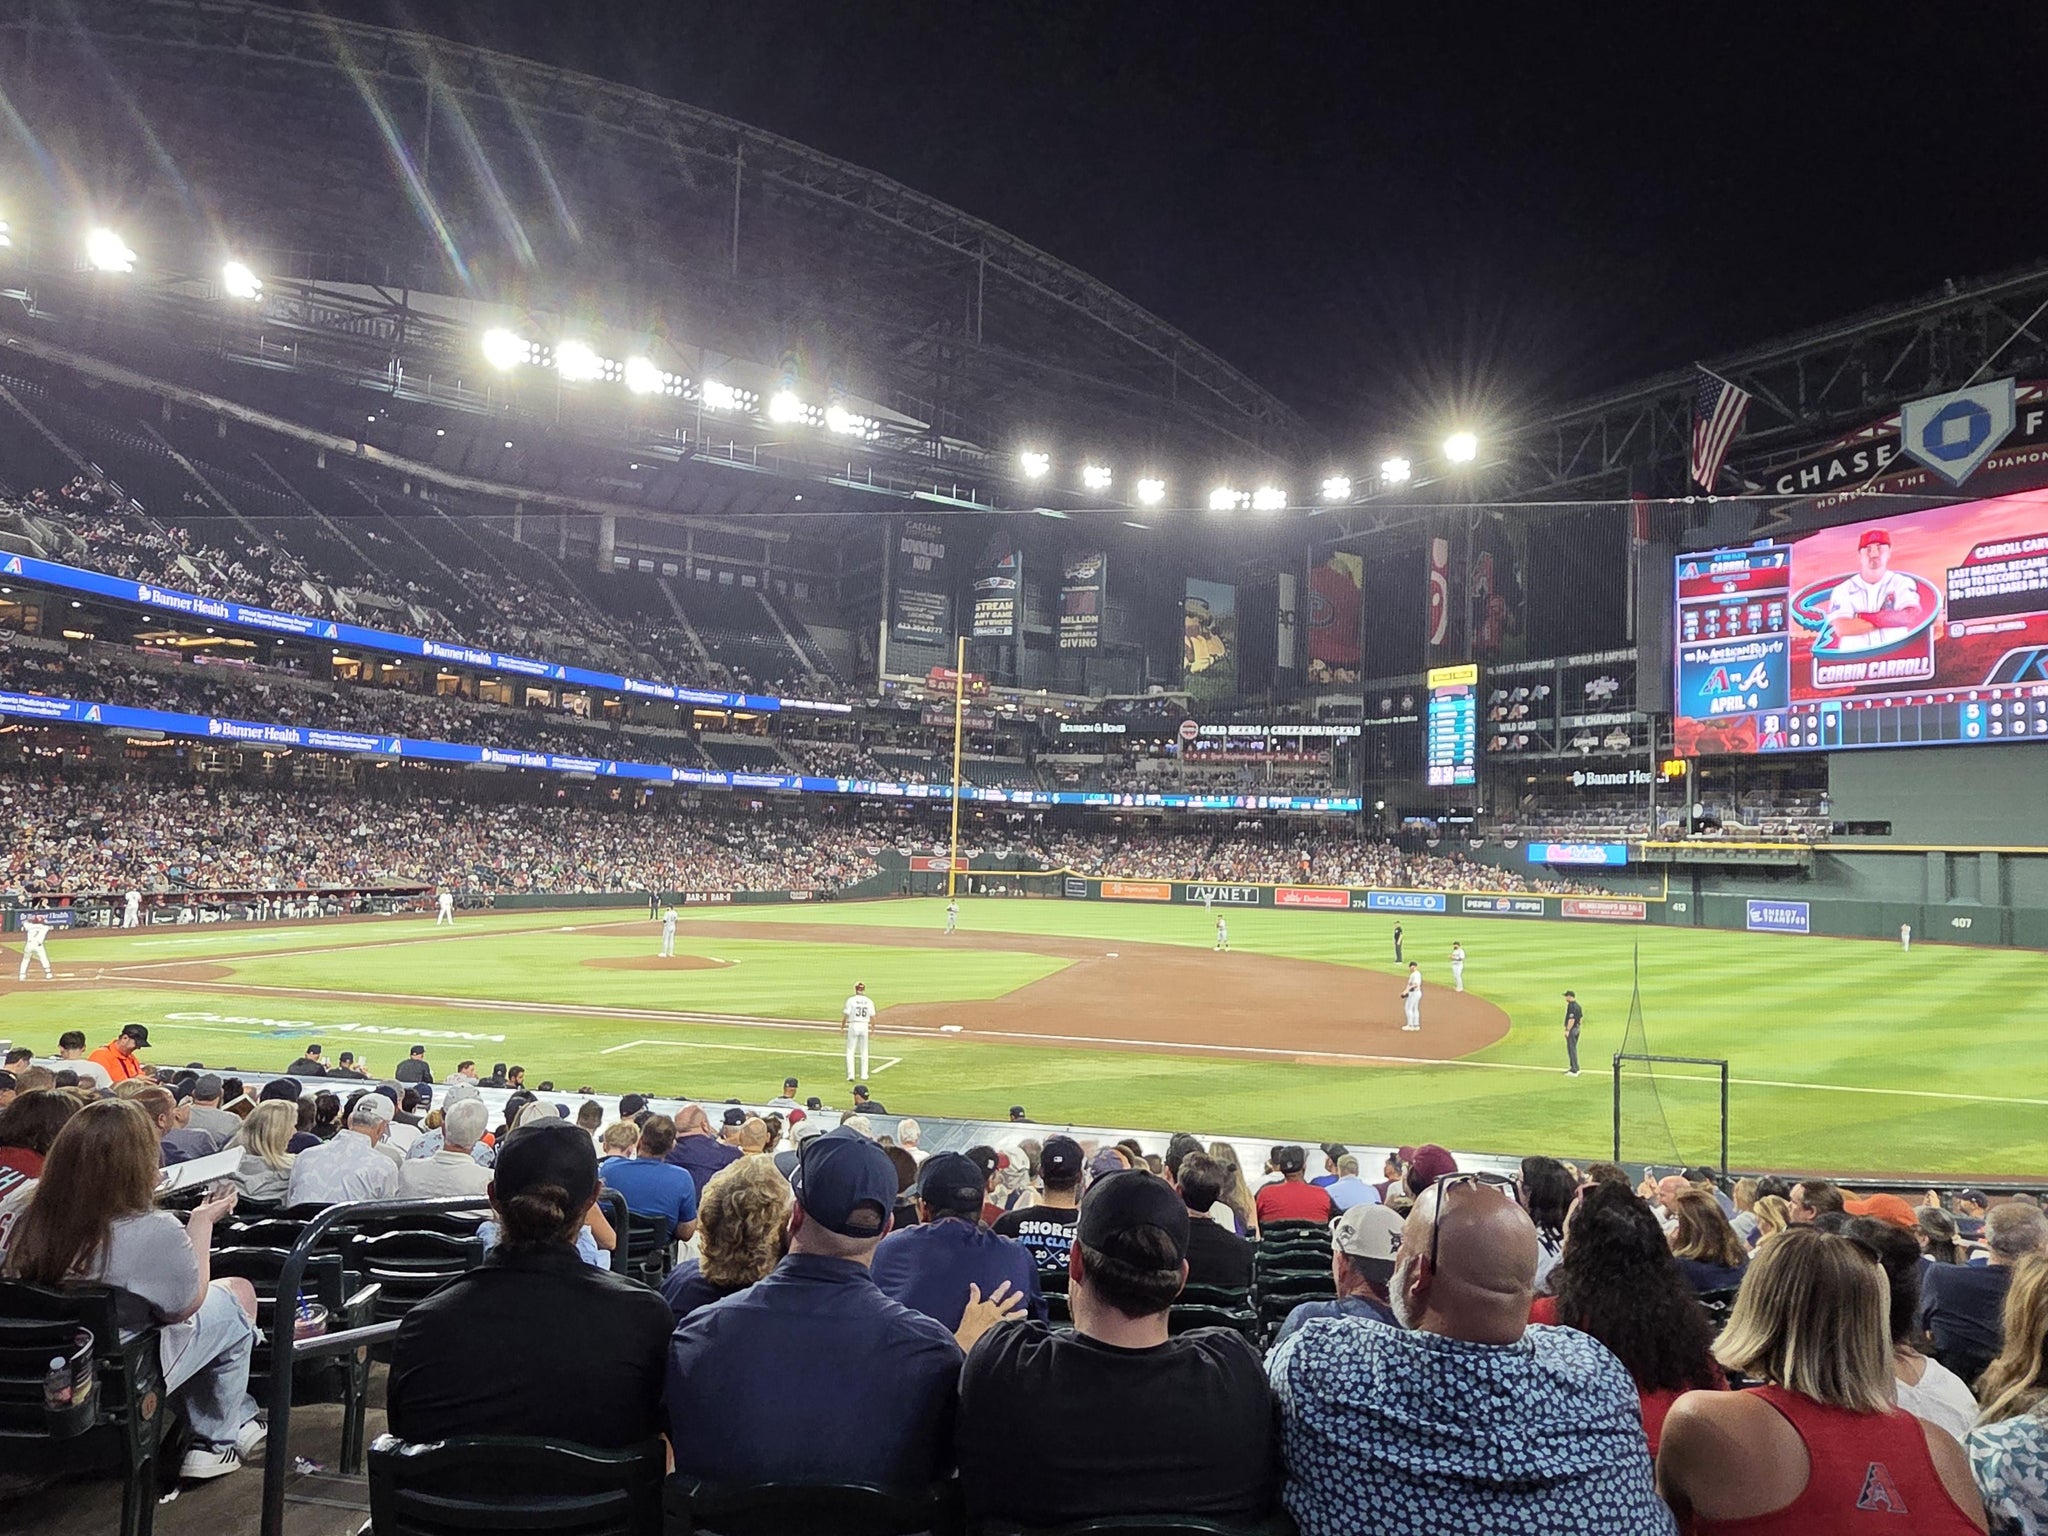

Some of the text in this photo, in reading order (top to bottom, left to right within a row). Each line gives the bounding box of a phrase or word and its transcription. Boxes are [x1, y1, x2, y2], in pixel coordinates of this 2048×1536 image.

[1776, 444, 1891, 494] CHASE
[1897, 474, 1926, 488] THE
[901, 538, 945, 558] DOWNLOAD
[1975, 541, 2022, 560] CARROLL
[1773, 553, 1785, 569] 7
[1948, 568, 1970, 580] LAST
[1971, 576, 1985, 587] TO
[1985, 571, 2022, 585] RECORD
[1964, 577, 2048, 599] STOLEN BASES IN A
[152, 590, 230, 619] Banner Health
[975, 601, 1013, 612] STREAM
[1061, 615, 1099, 624] MILLION
[1060, 638, 1098, 648] GIVING
[434, 644, 465, 660] Banner
[464, 650, 492, 665] Health
[1568, 652, 1593, 666] WORLD
[1515, 659, 1555, 672] CHAMPIONS
[1818, 656, 1930, 683] CORBIN CARROLL
[654, 685, 675, 698] Health
[1710, 693, 1759, 714] APRIL 4
[1585, 712, 1632, 725] CHAMPIONS
[1789, 716, 1801, 730] 0
[1807, 715, 1818, 729] 0
[1966, 703, 1980, 720] 5
[1990, 703, 2003, 717] 6
[2013, 701, 2026, 716] 0
[222, 722, 300, 743] Banner Health
[1199, 726, 1227, 736] COLD
[1228, 726, 1262, 736] BEERS
[1270, 726, 1361, 737] CHEESEBURGERS
[1500, 721, 1537, 732] WILD CARD
[1789, 733, 1801, 747] 0
[1806, 732, 1818, 746] 0
[1966, 721, 1980, 738] 0
[1991, 721, 2003, 736] 3
[2013, 720, 2026, 734] 0
[492, 750, 521, 764] Banner
[521, 753, 547, 767] Health
[702, 772, 727, 784] Health
[1587, 772, 1628, 785] Banner
[1194, 887, 1251, 901] AVNET
[1303, 894, 1343, 904] Budweiser
[1352, 899, 1366, 909] 374
[1377, 895, 1422, 908] CHASE
[1467, 900, 1541, 911] PEPSI PEPSI
[1672, 902, 1687, 912] 413
[1763, 915, 1806, 925] TRANSFER
[1951, 918, 1972, 929] 407
[855, 1006, 868, 1018] 36
[164, 1012, 506, 1042] CASINO ARIZONA
[1035, 1250, 1047, 1259] 20
